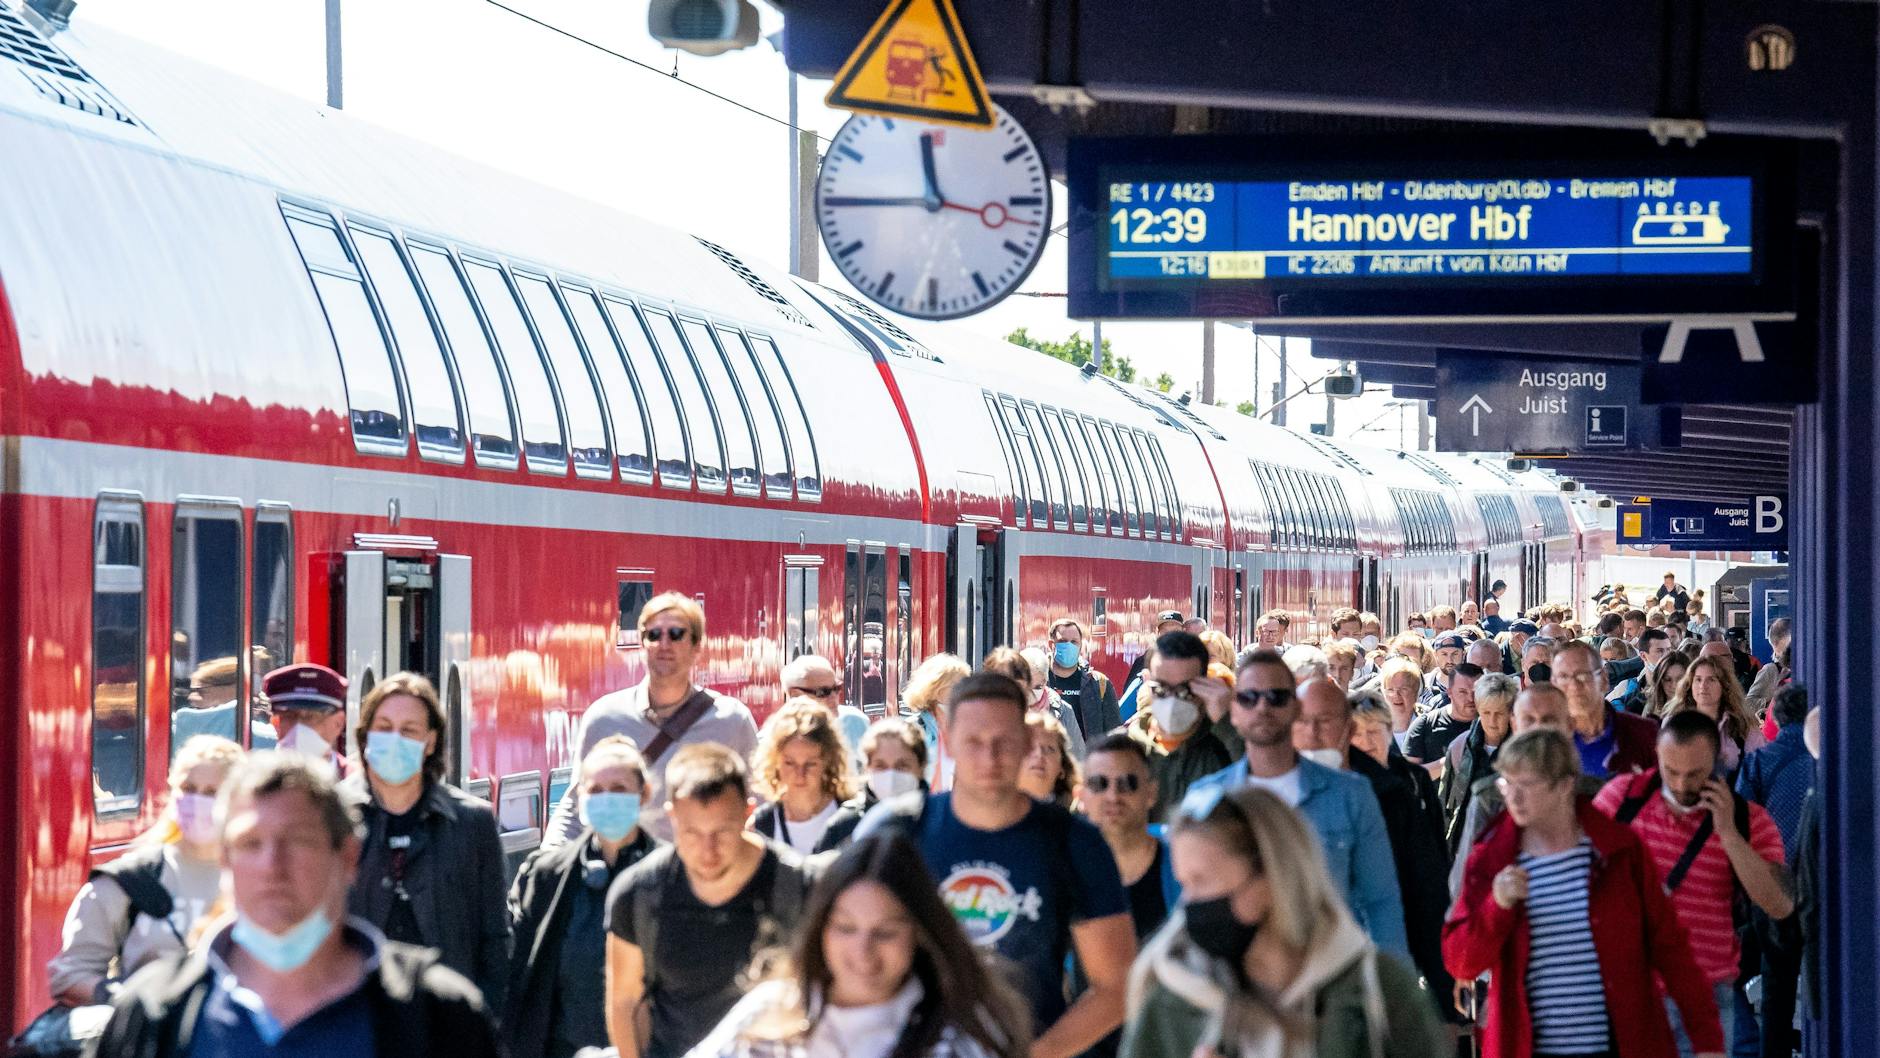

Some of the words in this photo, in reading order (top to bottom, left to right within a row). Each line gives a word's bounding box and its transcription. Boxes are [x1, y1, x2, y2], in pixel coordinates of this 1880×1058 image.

[1109, 183, 1133, 202] RE
[1139, 183, 1149, 202] 1
[1170, 182, 1215, 202] 4423
[1288, 182, 1348, 202] Emden
[1352, 181, 1385, 201] Hbf
[1569, 179, 1640, 199] Bremen
[1643, 178, 1677, 198] Hbf
[1110, 207, 1207, 243] 12:39
[1288, 206, 1456, 242] Hannover
[1470, 204, 1533, 240] Hbf
[1288, 255, 1307, 274] IC
[1311, 255, 1356, 274] 2206
[1369, 254, 1445, 274] Ankunft
[1449, 255, 1485, 273] von
[1489, 254, 1533, 272] Köln
[1535, 254, 1569, 272] Hbf
[1519, 368, 1607, 391] Ausgang
[1519, 395, 1568, 414] Juist
[1714, 507, 1749, 517] Ausgang
[1755, 495, 1784, 534] B
[1729, 518, 1749, 527] Juist
